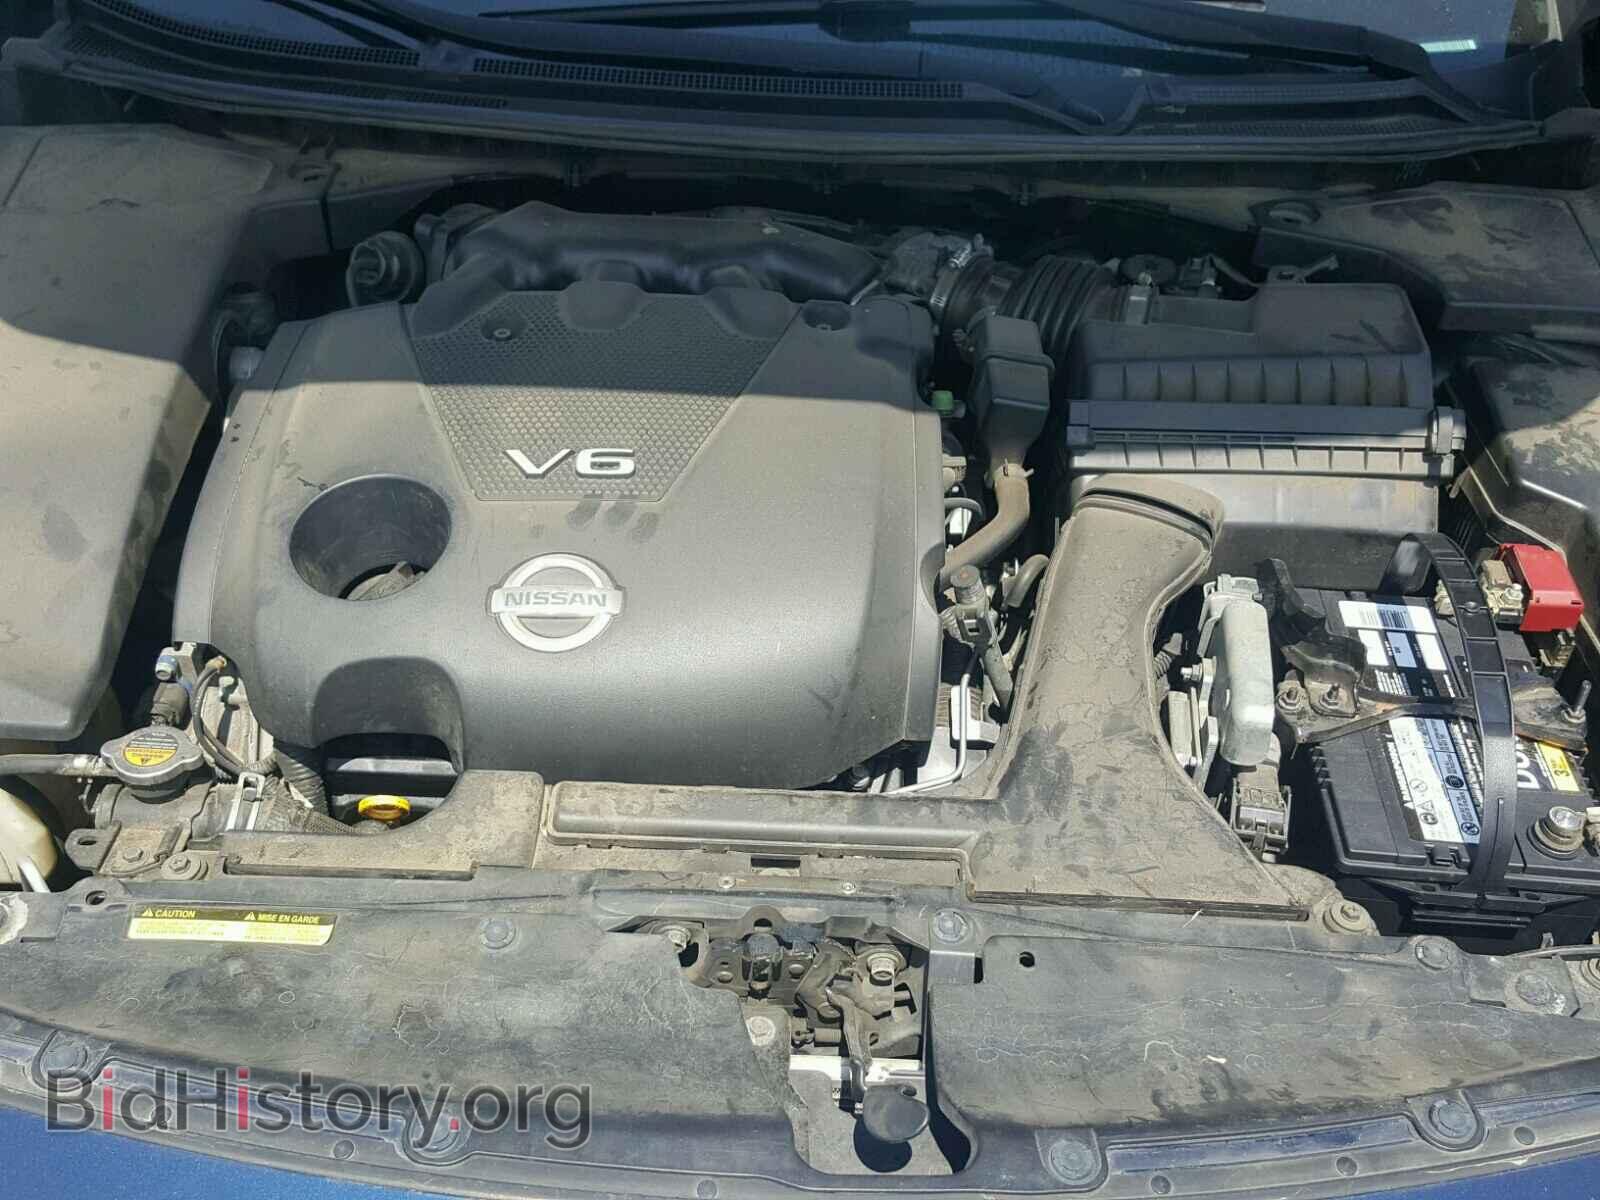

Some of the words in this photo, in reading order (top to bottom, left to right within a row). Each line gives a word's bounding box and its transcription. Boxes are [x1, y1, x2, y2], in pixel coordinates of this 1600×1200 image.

[504, 448, 636, 477] V6
[504, 591, 607, 607] NISSAN
[154, 909, 196, 918] CAUTION
[257, 913, 278, 922] MISE
[278, 914, 290, 923] EN
[291, 914, 320, 924] GARDE
